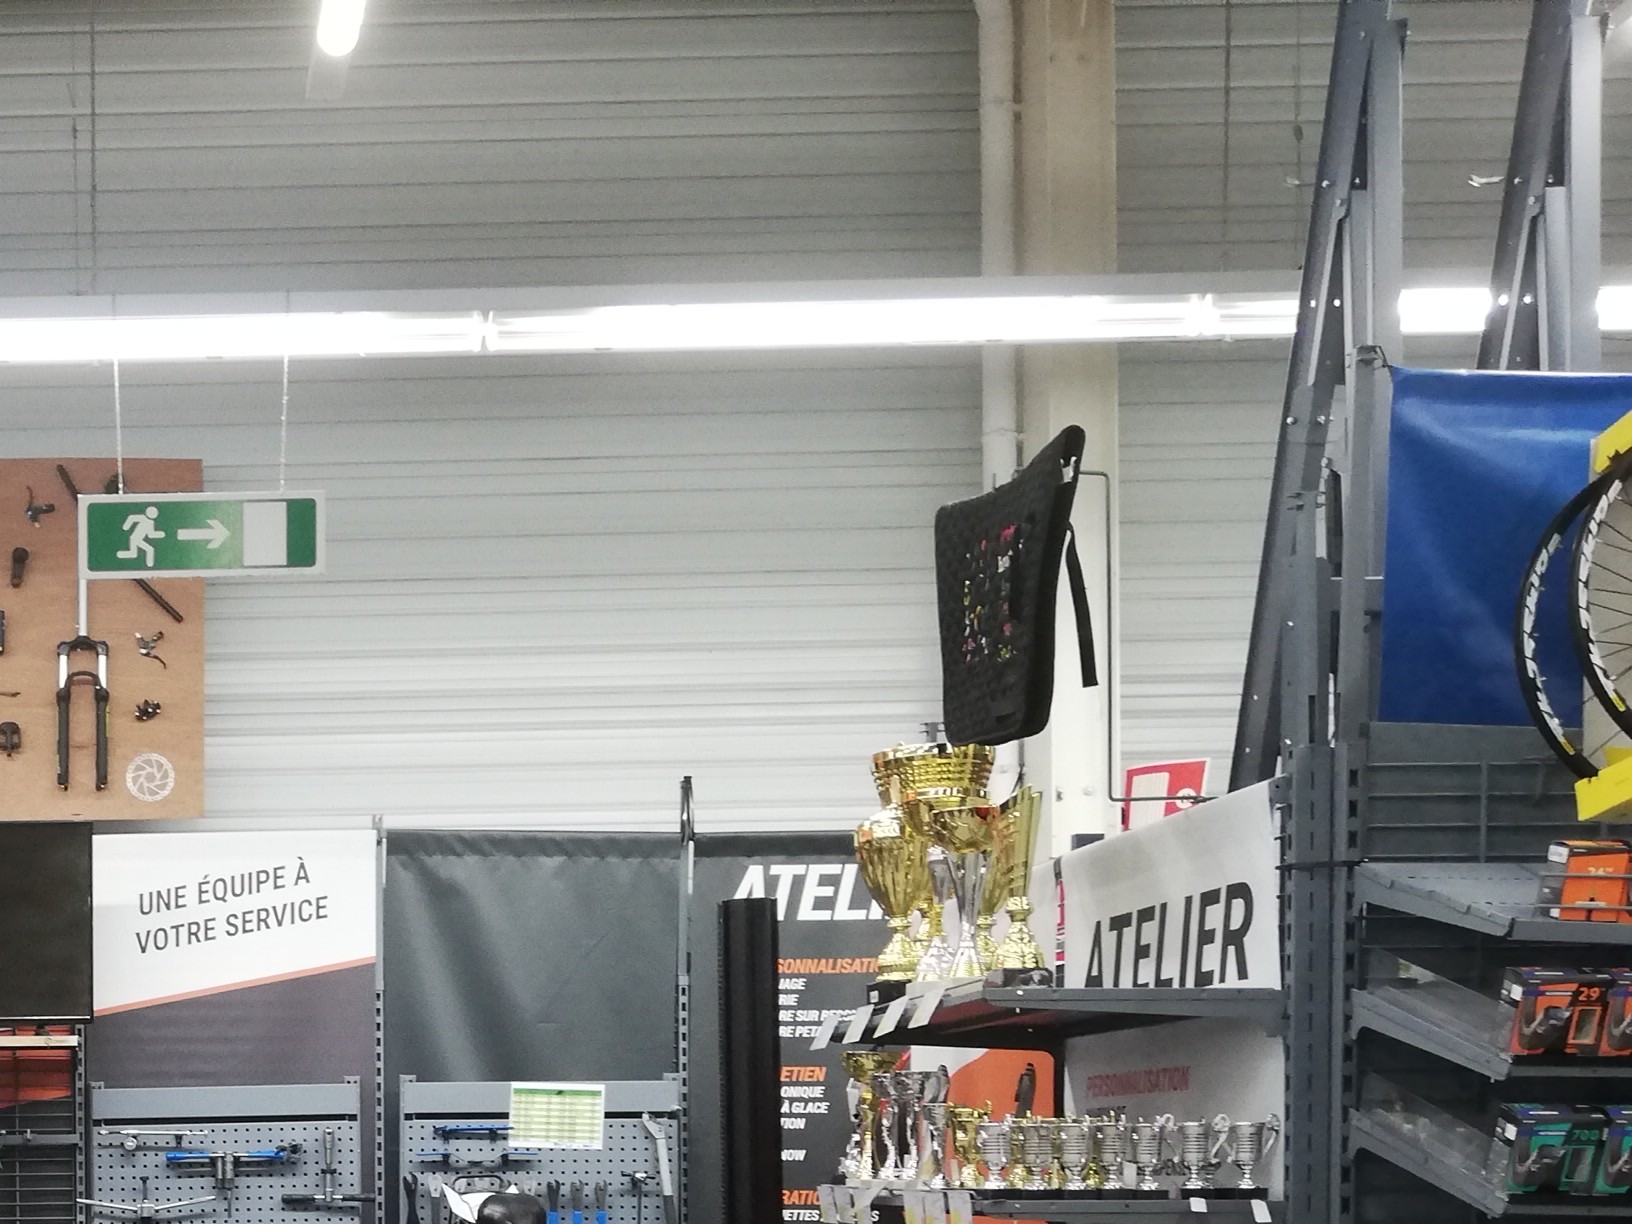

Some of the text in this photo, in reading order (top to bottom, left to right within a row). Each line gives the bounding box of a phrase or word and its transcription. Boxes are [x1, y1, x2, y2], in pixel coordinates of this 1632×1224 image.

[138, 856, 312, 916] UNE ÉQUIPE À
[733, 863, 888, 922] ATEL
[135, 895, 329, 955] VOTRE SERVICE
[1084, 881, 1254, 988] ATELIER
[777, 957, 880, 974] SONNALISATI
[780, 1066, 826, 1082] ETIEN
[781, 1086, 825, 1099] ONIQUE
[792, 1102, 830, 1114] GLACE
